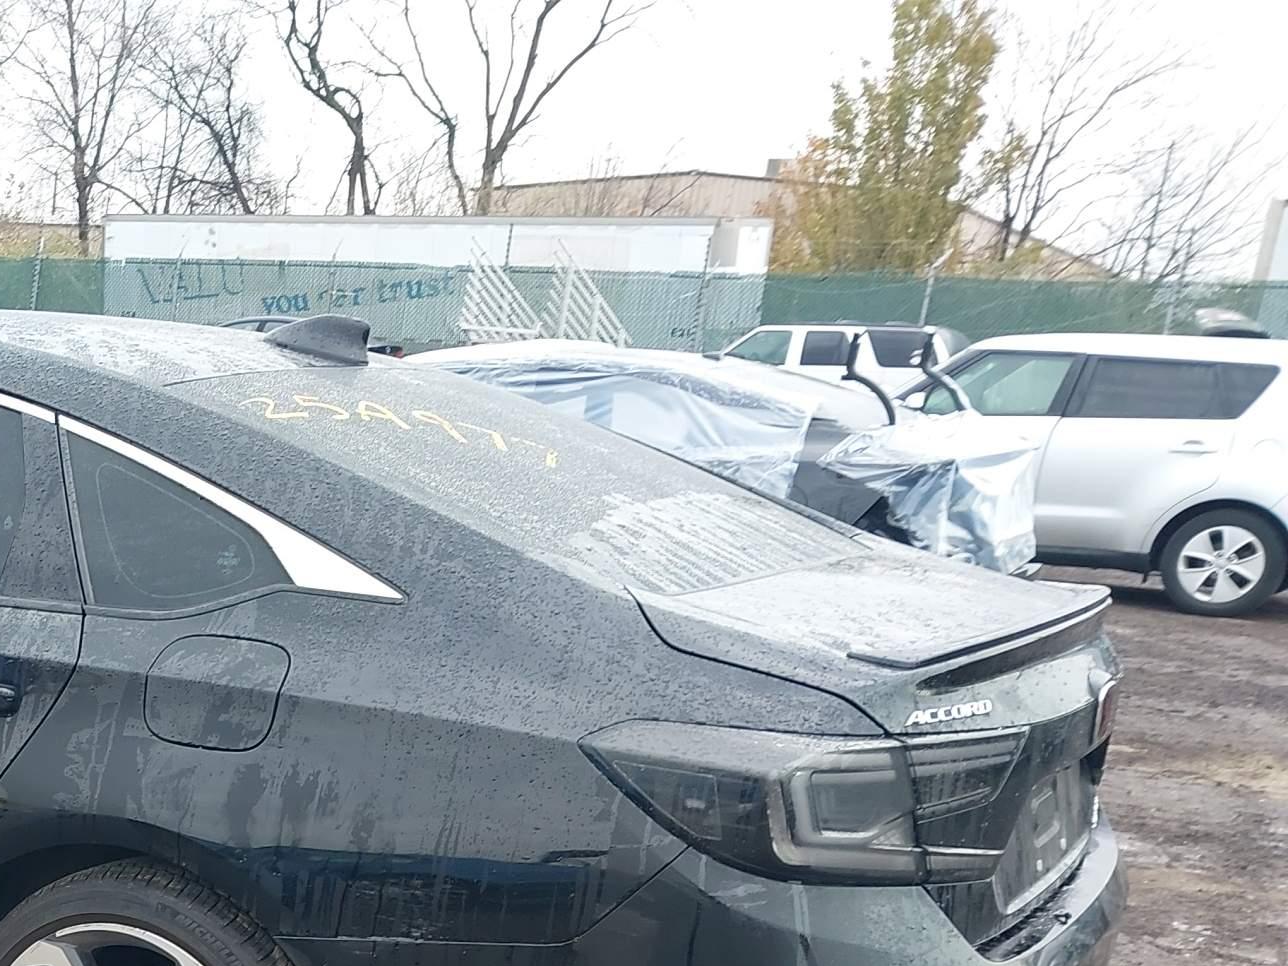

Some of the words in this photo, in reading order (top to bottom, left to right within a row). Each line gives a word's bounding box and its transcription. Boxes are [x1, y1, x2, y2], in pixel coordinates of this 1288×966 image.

[262, 290, 310, 315] you
[377, 274, 455, 303] trust
[903, 699, 992, 727] ACCORD
